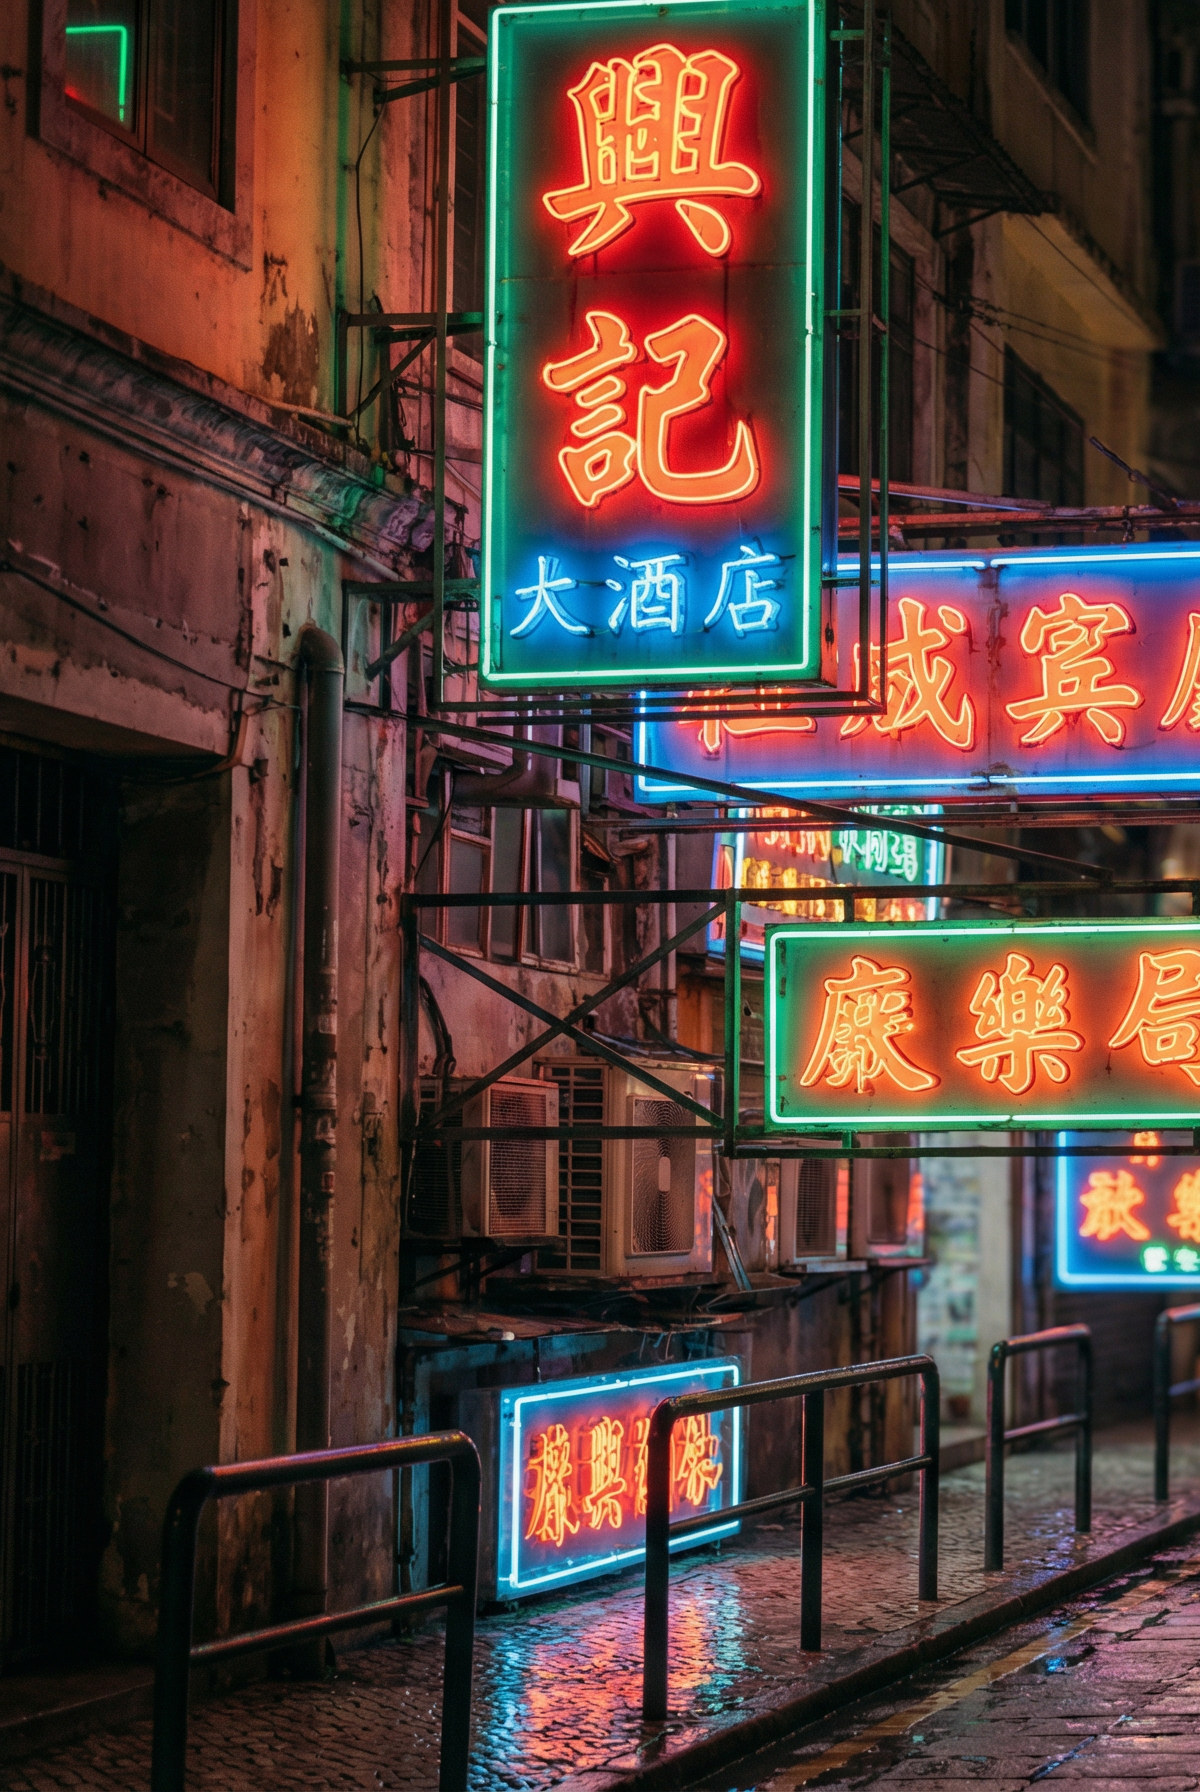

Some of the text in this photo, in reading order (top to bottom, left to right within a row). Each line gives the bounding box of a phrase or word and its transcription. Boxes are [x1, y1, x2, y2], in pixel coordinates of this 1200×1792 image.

[542, 42, 762, 508] 興記
[508, 543, 784, 638] 大酒店
